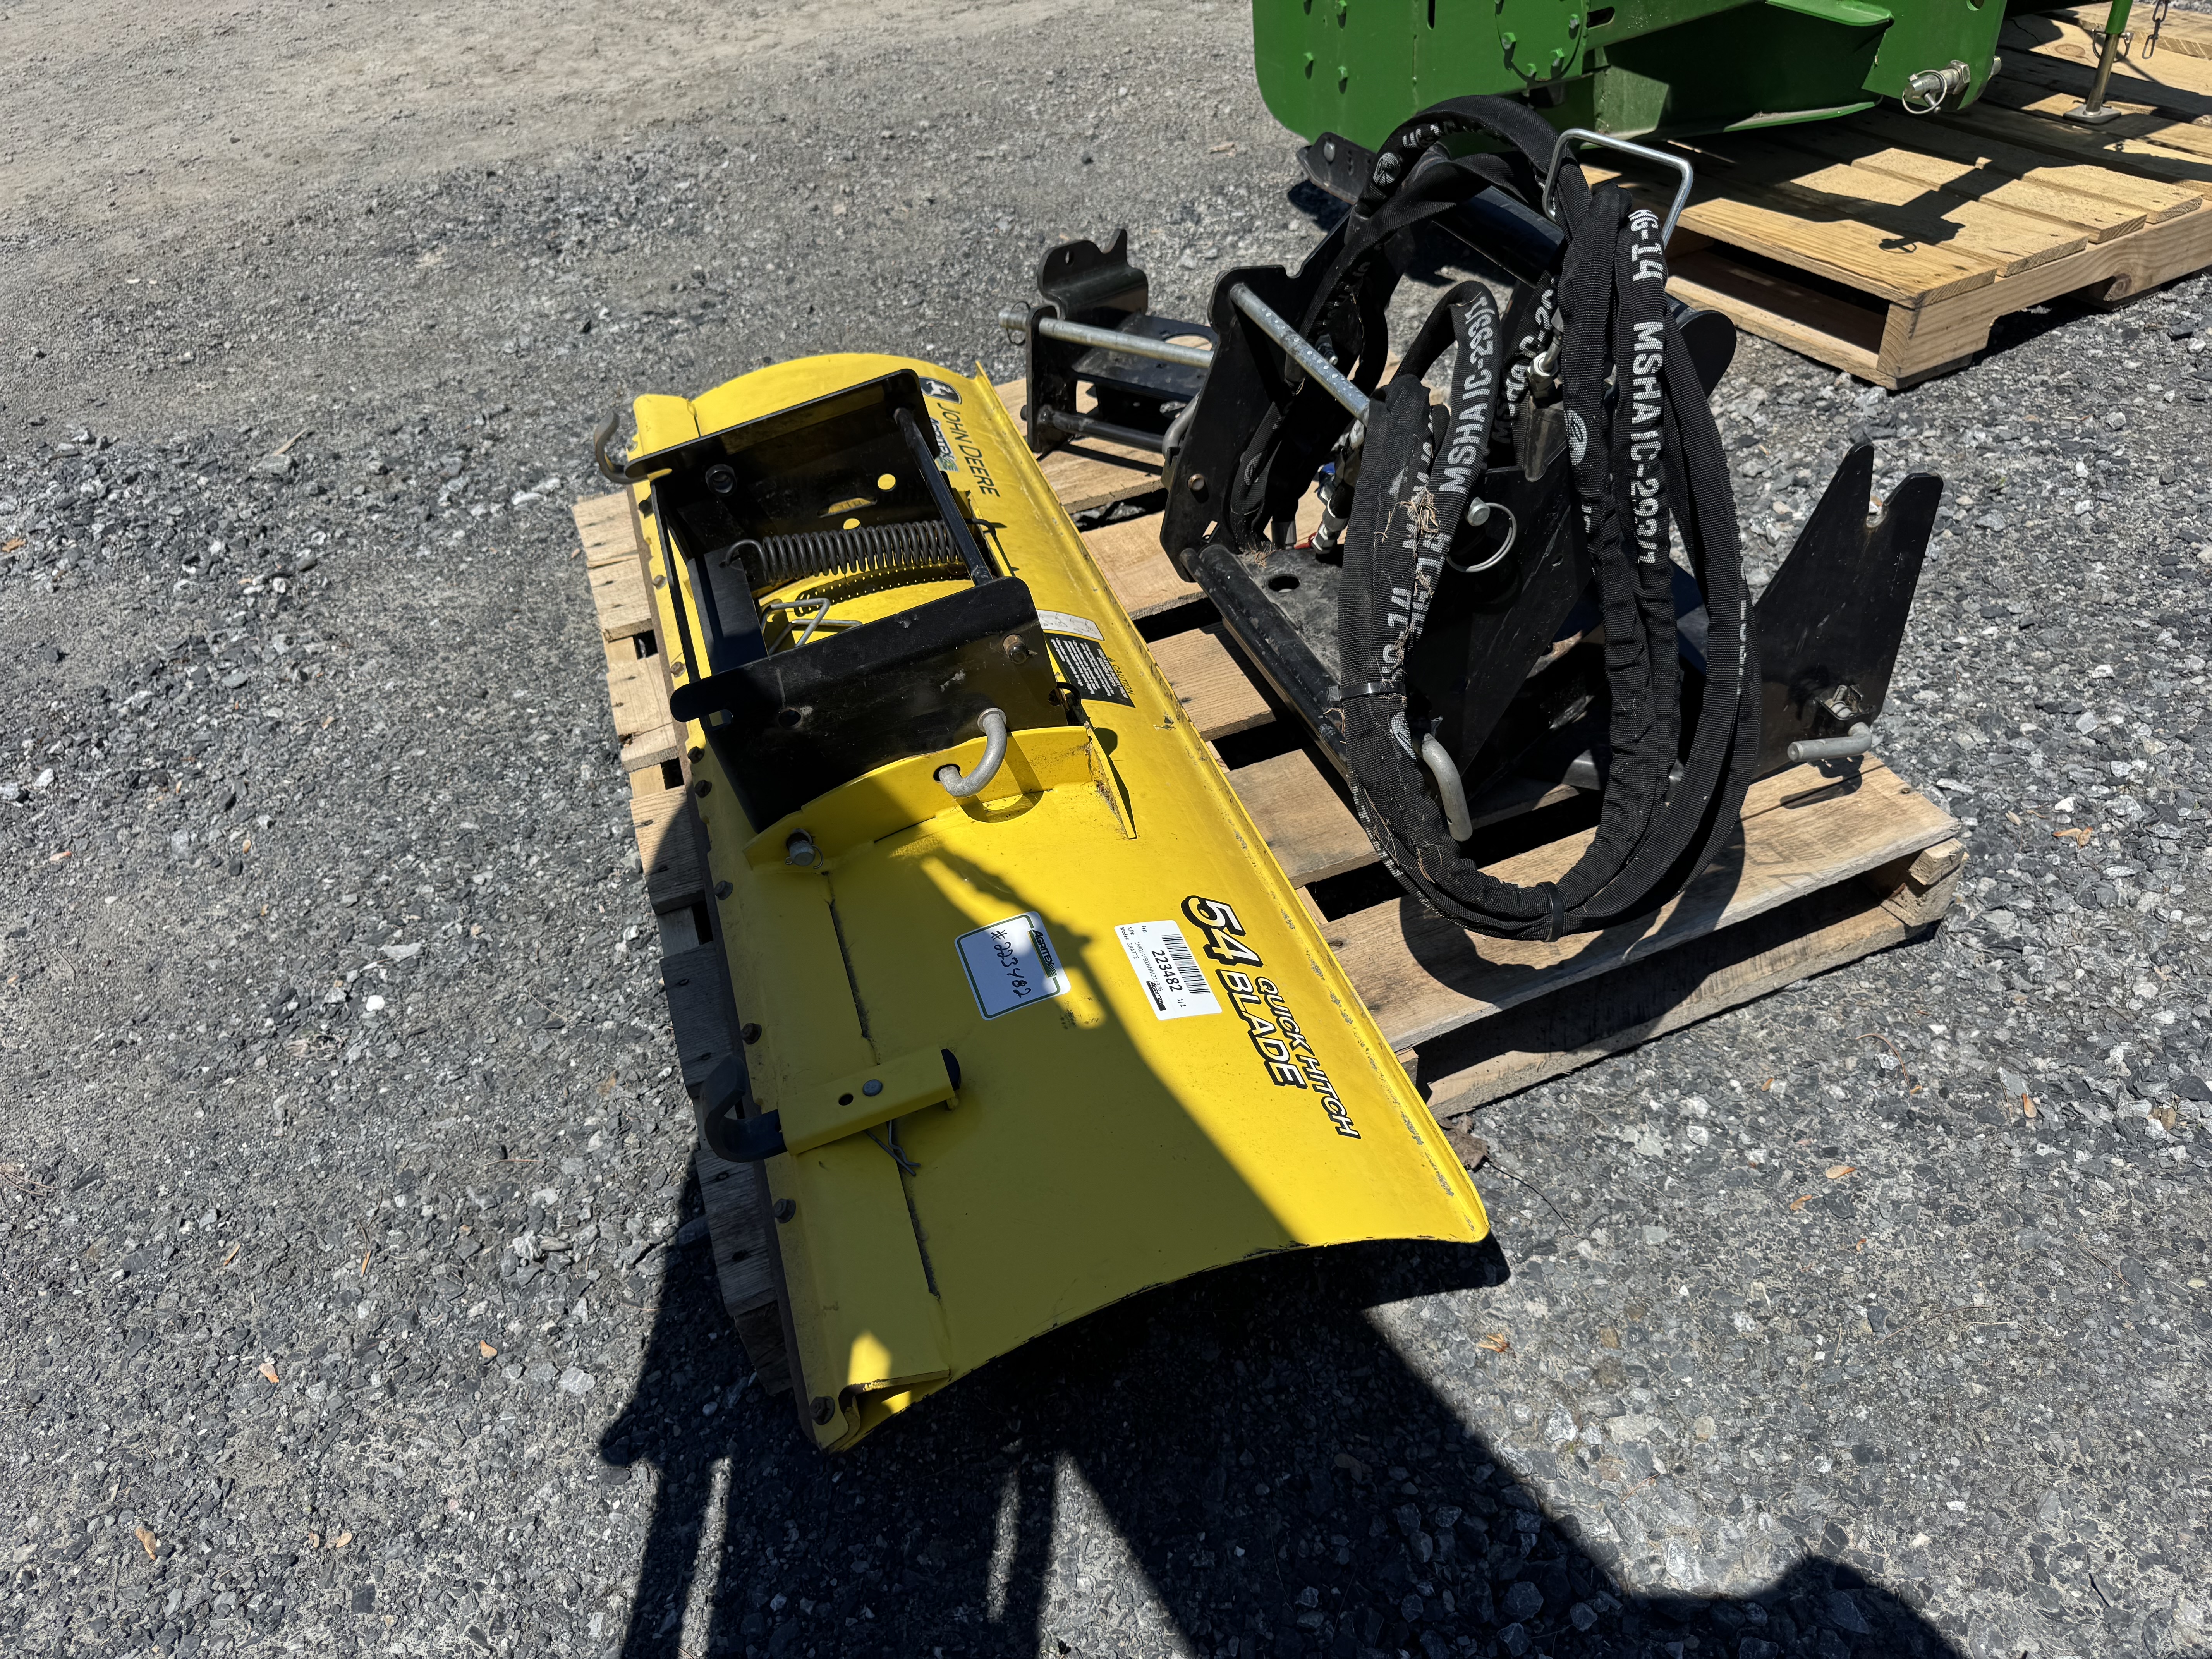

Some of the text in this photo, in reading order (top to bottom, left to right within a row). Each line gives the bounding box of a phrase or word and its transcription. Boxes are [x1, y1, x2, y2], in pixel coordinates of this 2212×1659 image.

[1630, 321, 1664, 424] MSHA
[937, 402, 1001, 497] JOHN DEERE
[1439, 403, 1488, 493] MSHA
[1113, 665, 1135, 695] CAUTION
[1032, 929, 1054, 966] AGRITEX
[1120, 927, 1139, 959] Model: GRATTE
[1181, 895, 1264, 967] 54
[1151, 950, 1183, 992] 223482
[1177, 998, 1186, 1008] 1/1
[1215, 969, 1308, 1089] BLADE
[1255, 976, 1361, 1139] QUICK HITCH
